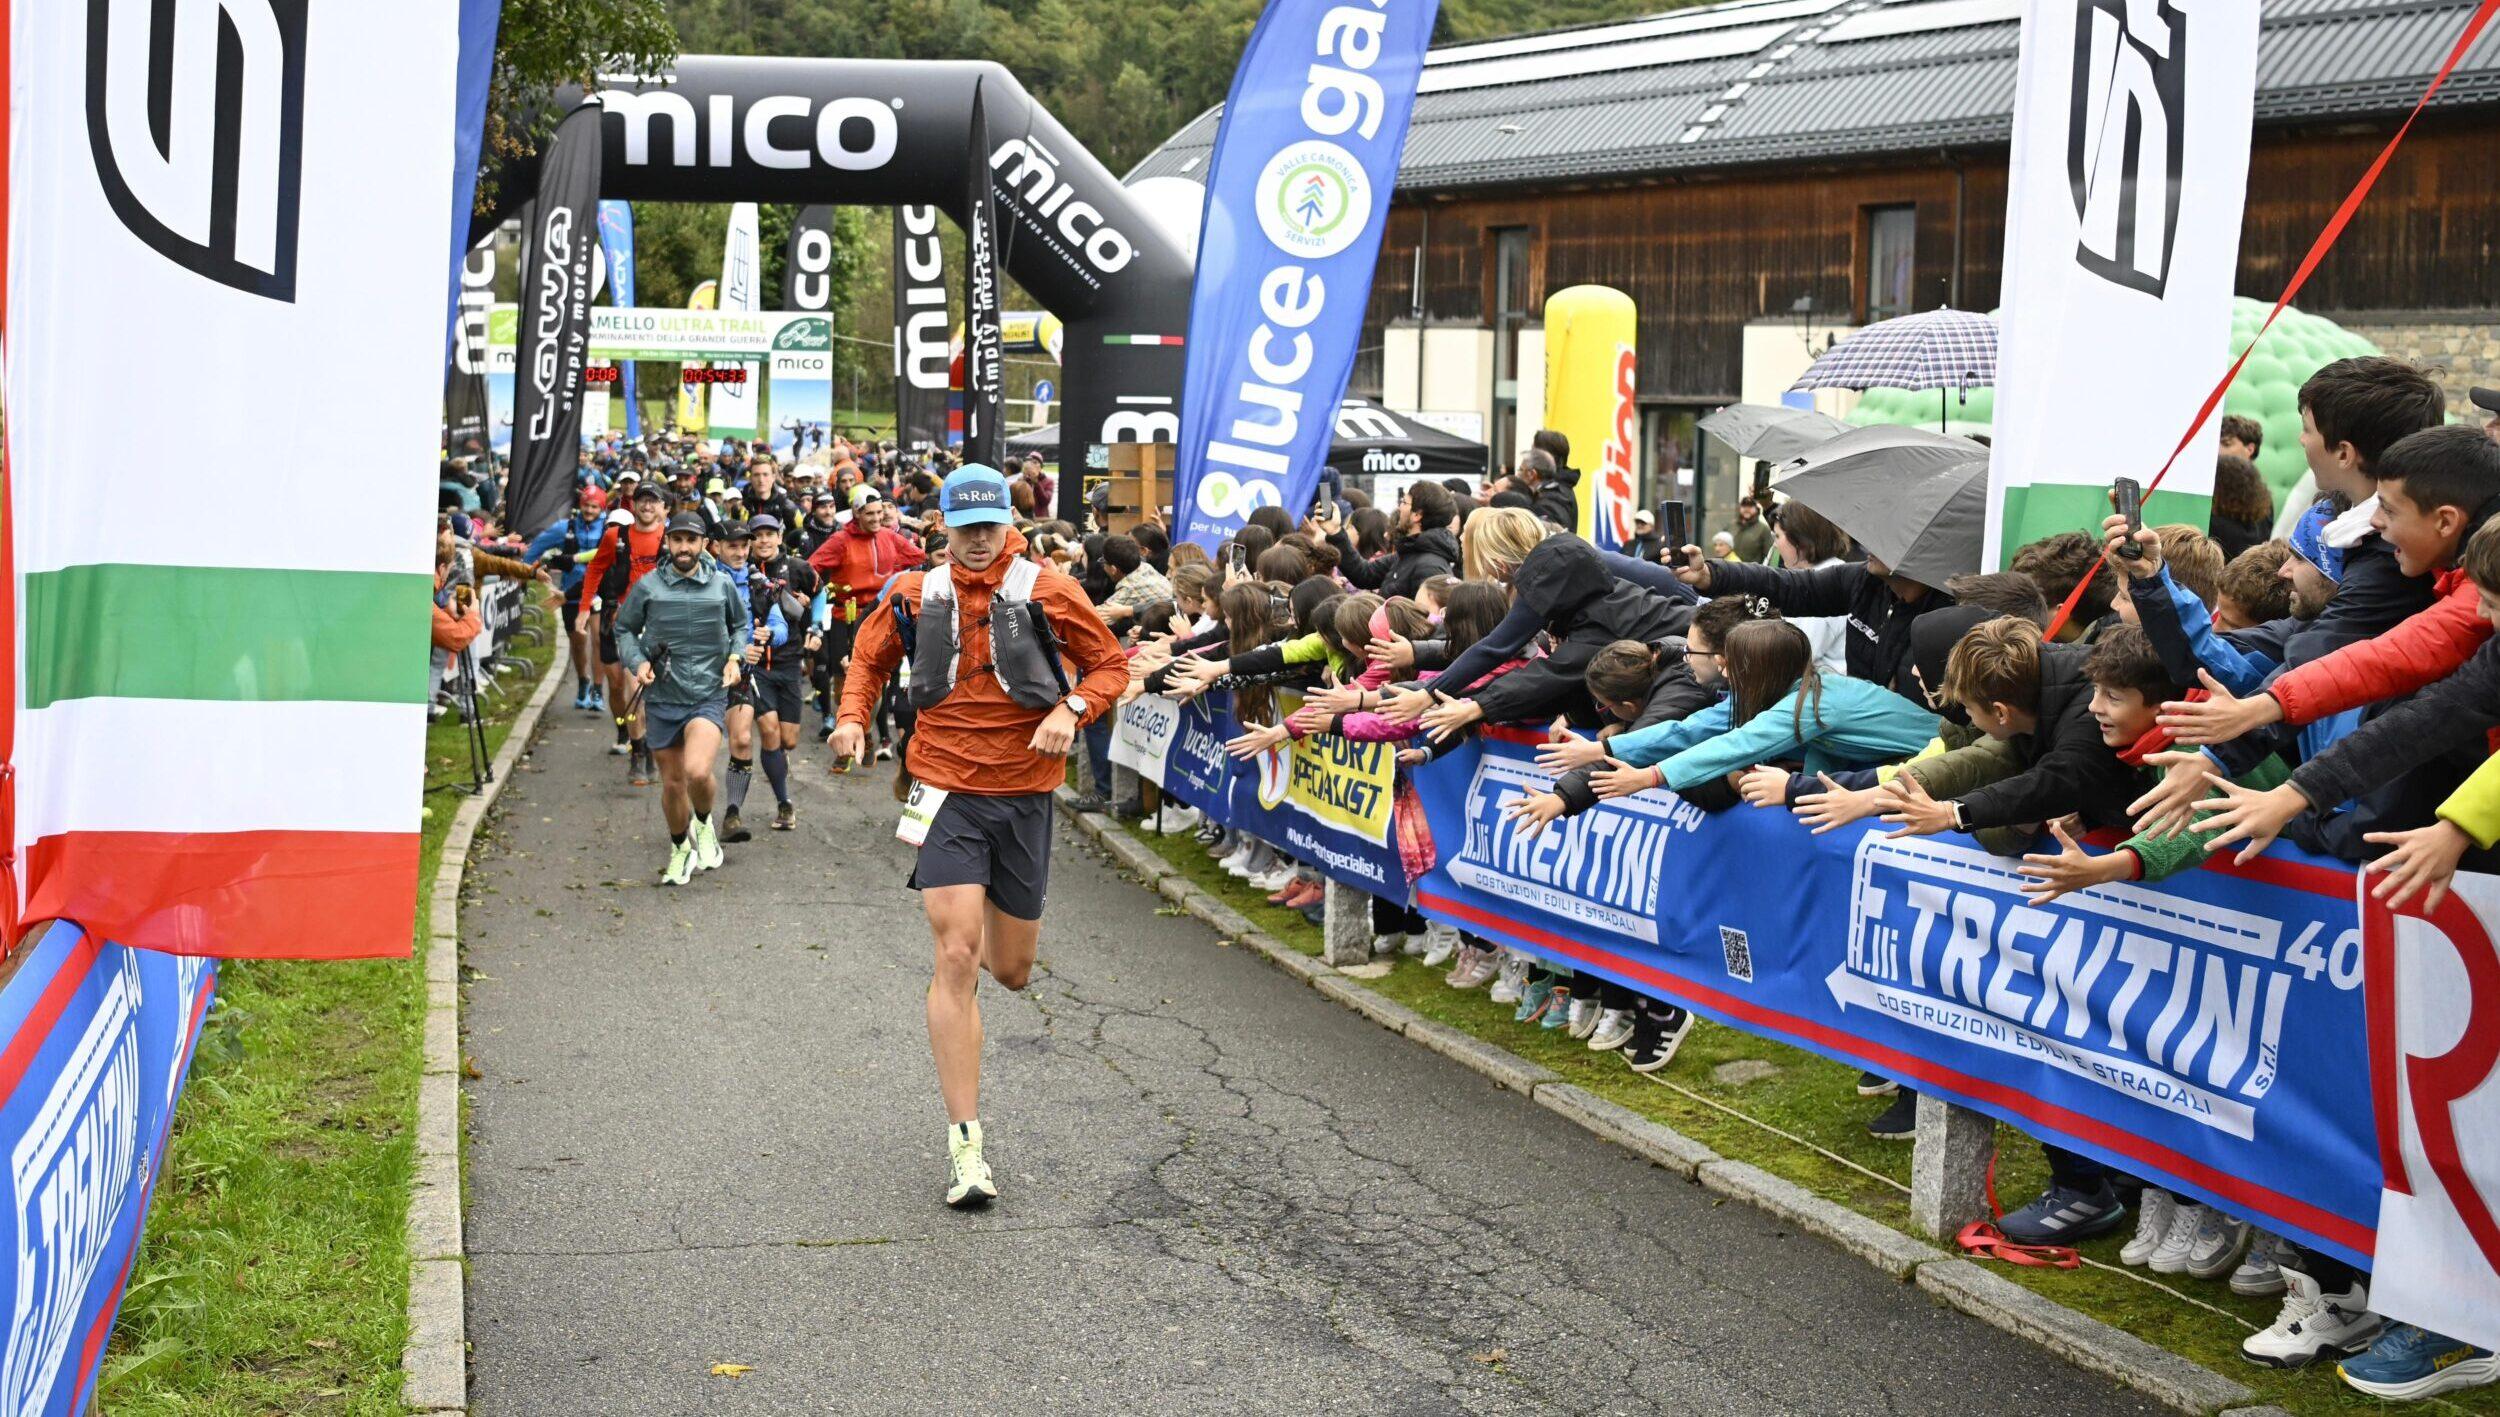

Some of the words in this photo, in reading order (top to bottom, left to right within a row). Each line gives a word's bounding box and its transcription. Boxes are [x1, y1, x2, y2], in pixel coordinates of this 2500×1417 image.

[1300, 0, 1388, 142] ga
[1277, 153, 1308, 178] VALLE
[1310, 152, 1359, 194] CAMONICA
[1025, 217, 1042, 236] FOR
[1042, 234, 1101, 291] PERFORMANCE
[1284, 229, 1326, 247] SERVIZI
[656, 334, 686, 344] DELLA
[688, 335, 728, 345] GRANDE
[729, 336, 769, 346] GUERRA
[660, 317, 716, 333] ULTRA
[719, 319, 768, 334] TRAIL
[561, 329, 585, 412] simply
[684, 369, 747, 383] 00:54:33
[970, 490, 996, 502] Rab
[1190, 521, 1210, 533] per
[1211, 523, 1222, 535] la
[1223, 526, 1237, 538] tu
[1006, 607, 1020, 631] Rab
[1293, 754, 1383, 820] SPECIALIST
[1493, 788, 1672, 917] TRENTINI
[1475, 872, 1541, 905] COSTRUZIONI
[1544, 892, 1571, 912] EDILI
[1575, 902, 1582, 916] E
[1585, 905, 1636, 933] STRADALI
[1907, 878, 2293, 1101] TRENTINI
[2283, 919, 2366, 990] 40
[1876, 991, 2007, 1043] COSTRUZIONI
[2015, 1031, 2068, 1063] EDILI
[2074, 1054, 2090, 1070] E
[2091, 1061, 2212, 1116] STRADALI
[2432, 1343, 2475, 1372] HOKA
